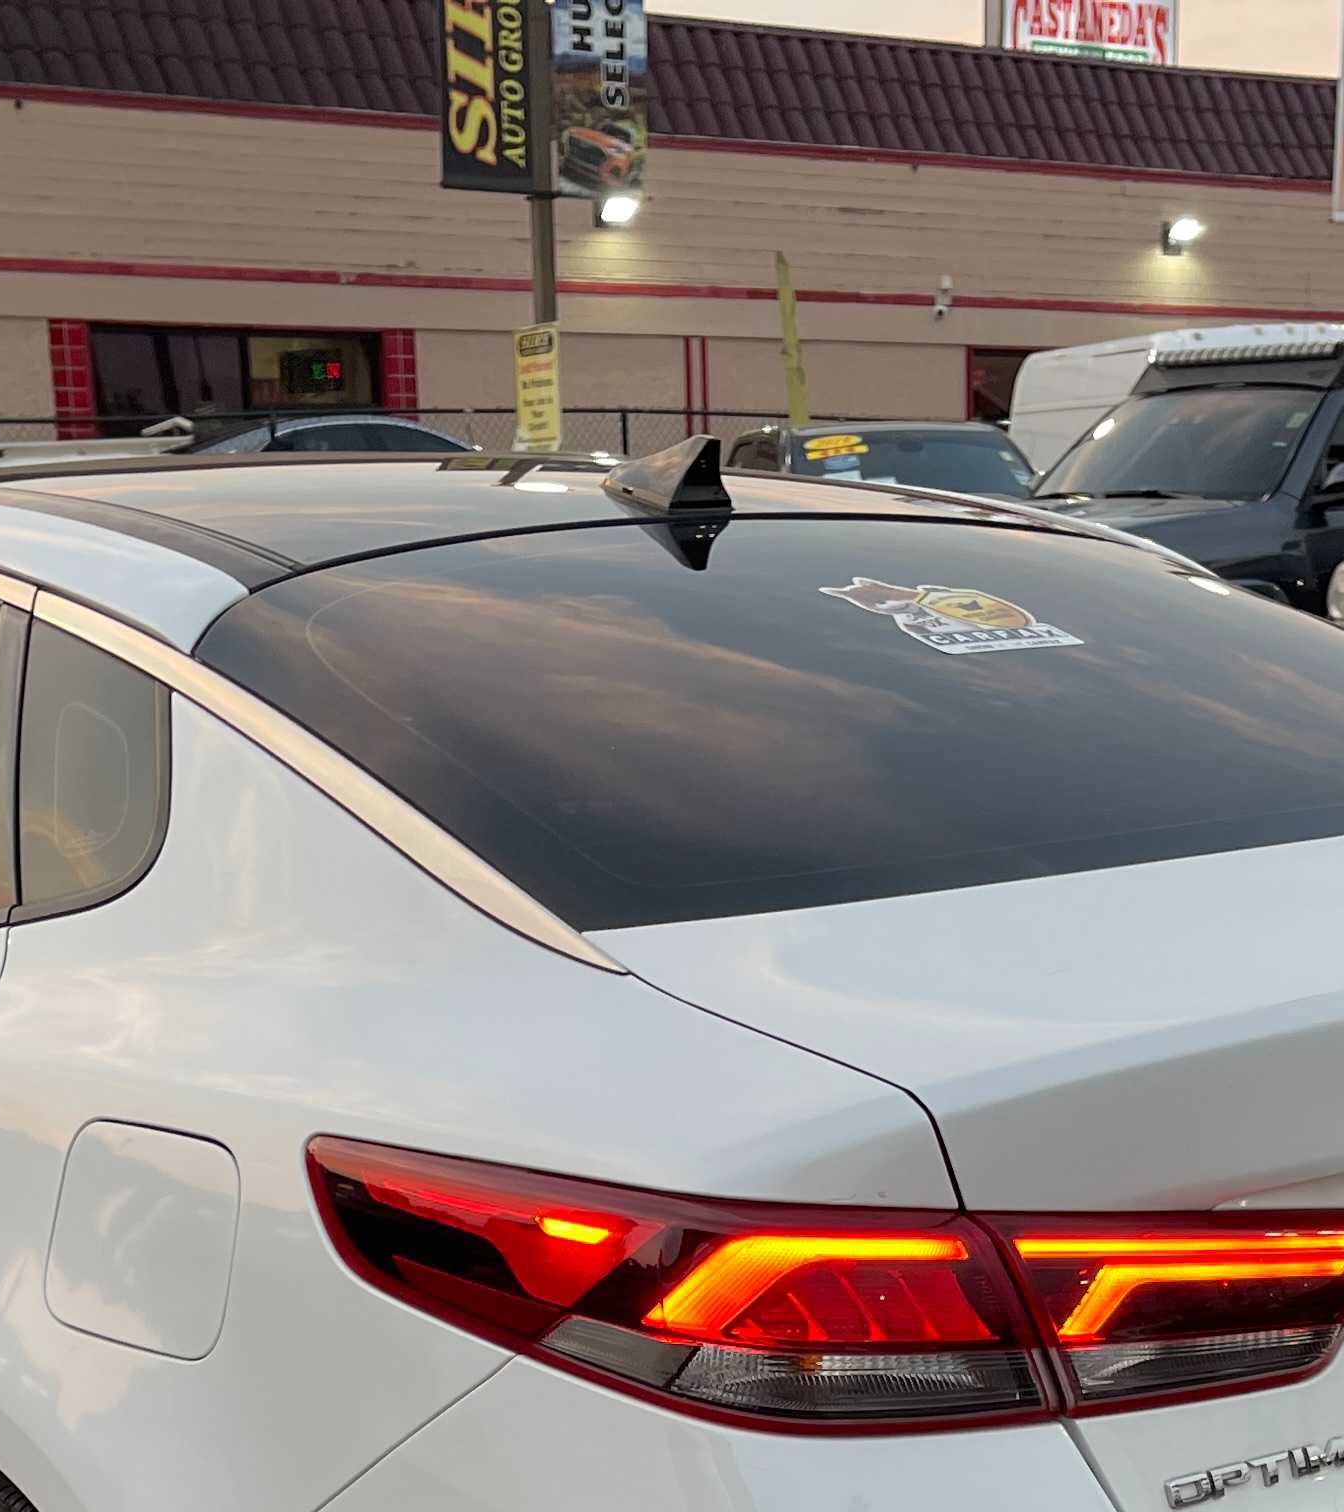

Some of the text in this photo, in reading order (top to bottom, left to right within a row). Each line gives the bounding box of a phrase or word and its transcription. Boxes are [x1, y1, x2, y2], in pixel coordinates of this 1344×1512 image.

[571, 0, 593, 52] HU
[604, 0, 626, 109] SELEC
[497, 0, 526, 169] AUTO GRO
[924, 627, 1060, 646] CARFAX
